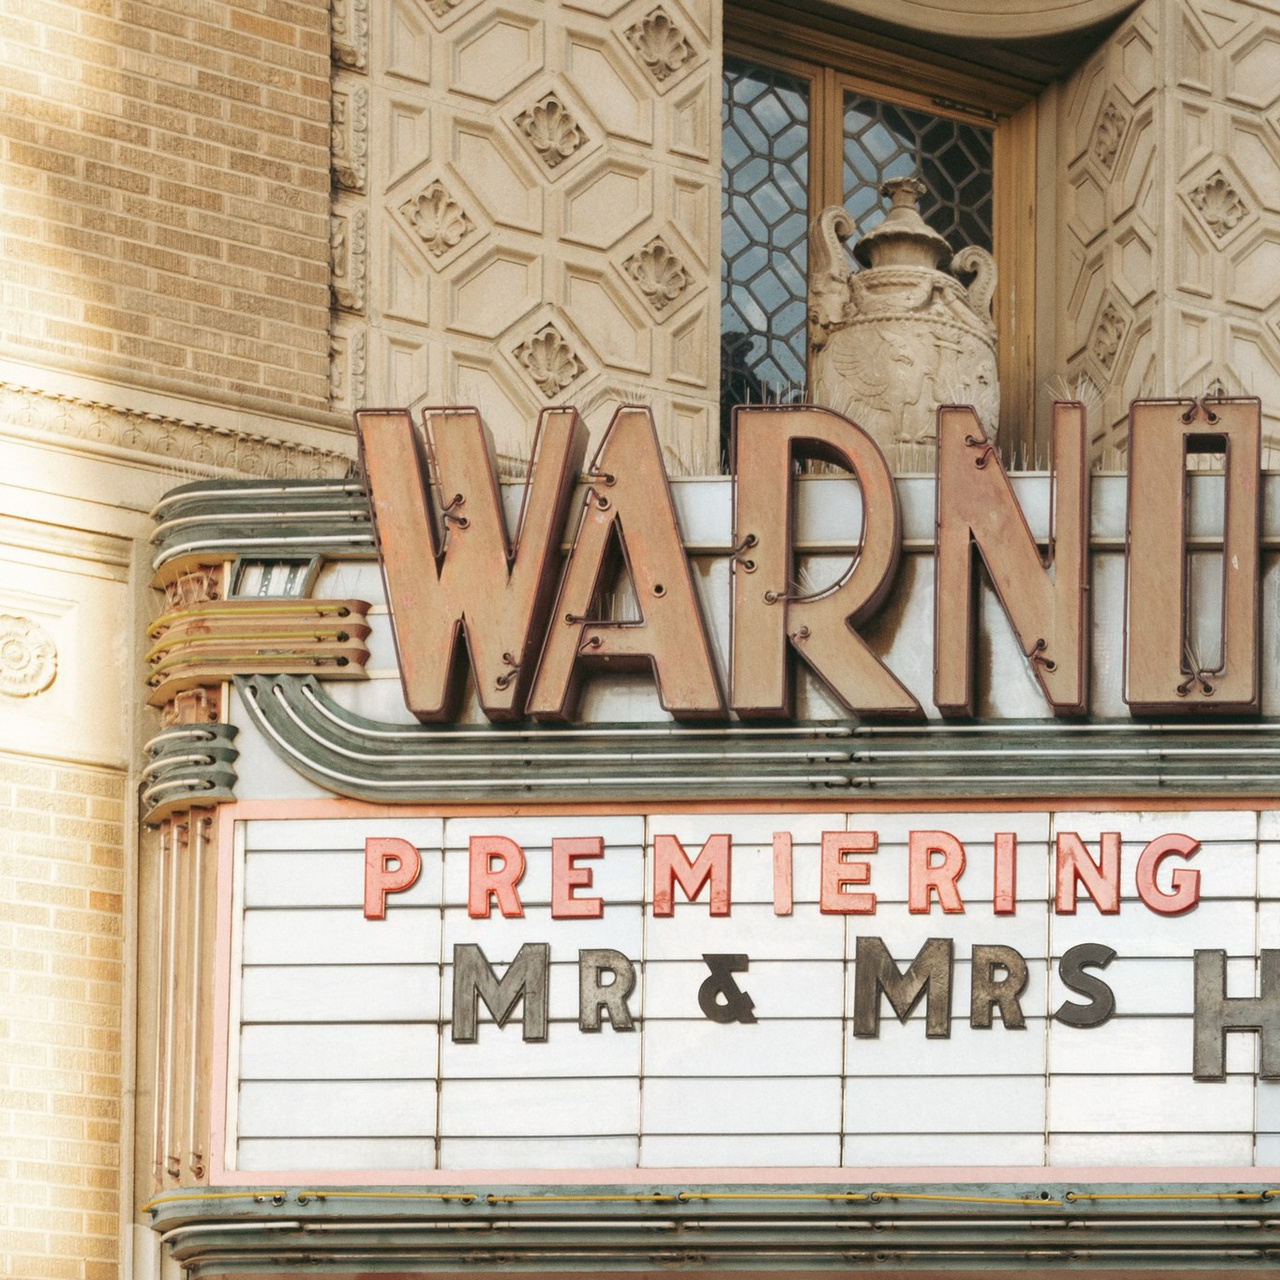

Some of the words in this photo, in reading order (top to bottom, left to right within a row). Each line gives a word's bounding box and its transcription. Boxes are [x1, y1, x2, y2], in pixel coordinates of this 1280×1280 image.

[362, 829, 1201, 920] PREMIERING
[450, 941, 637, 1044] MR
[697, 952, 758, 1025] &
[852, 935, 1117, 1039] MRS
